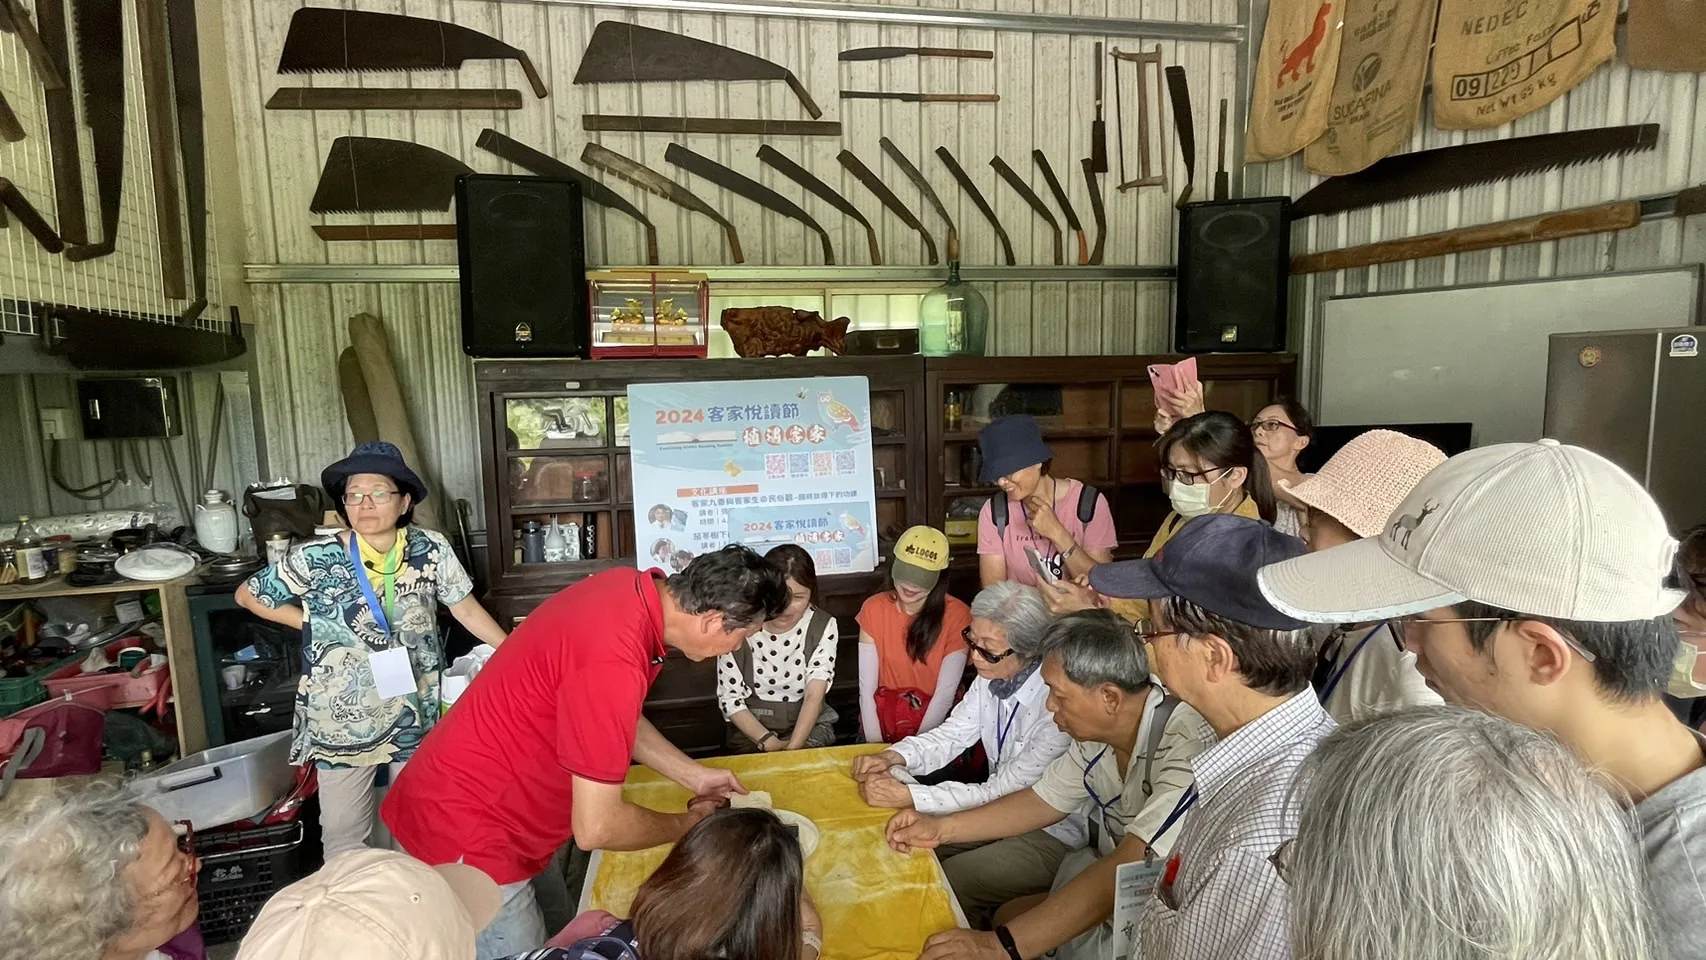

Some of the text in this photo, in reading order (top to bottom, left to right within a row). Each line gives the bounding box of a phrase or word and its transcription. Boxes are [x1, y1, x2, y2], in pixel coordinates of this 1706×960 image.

[1456, 78, 1481, 97] 09
[1333, 80, 1391, 120] SUCAFINA
[655, 403, 800, 425] 2024 客家悅讀節
[744, 518, 828, 532] 2024 客家悅讀節
[916, 546, 938, 560] LOGOS
